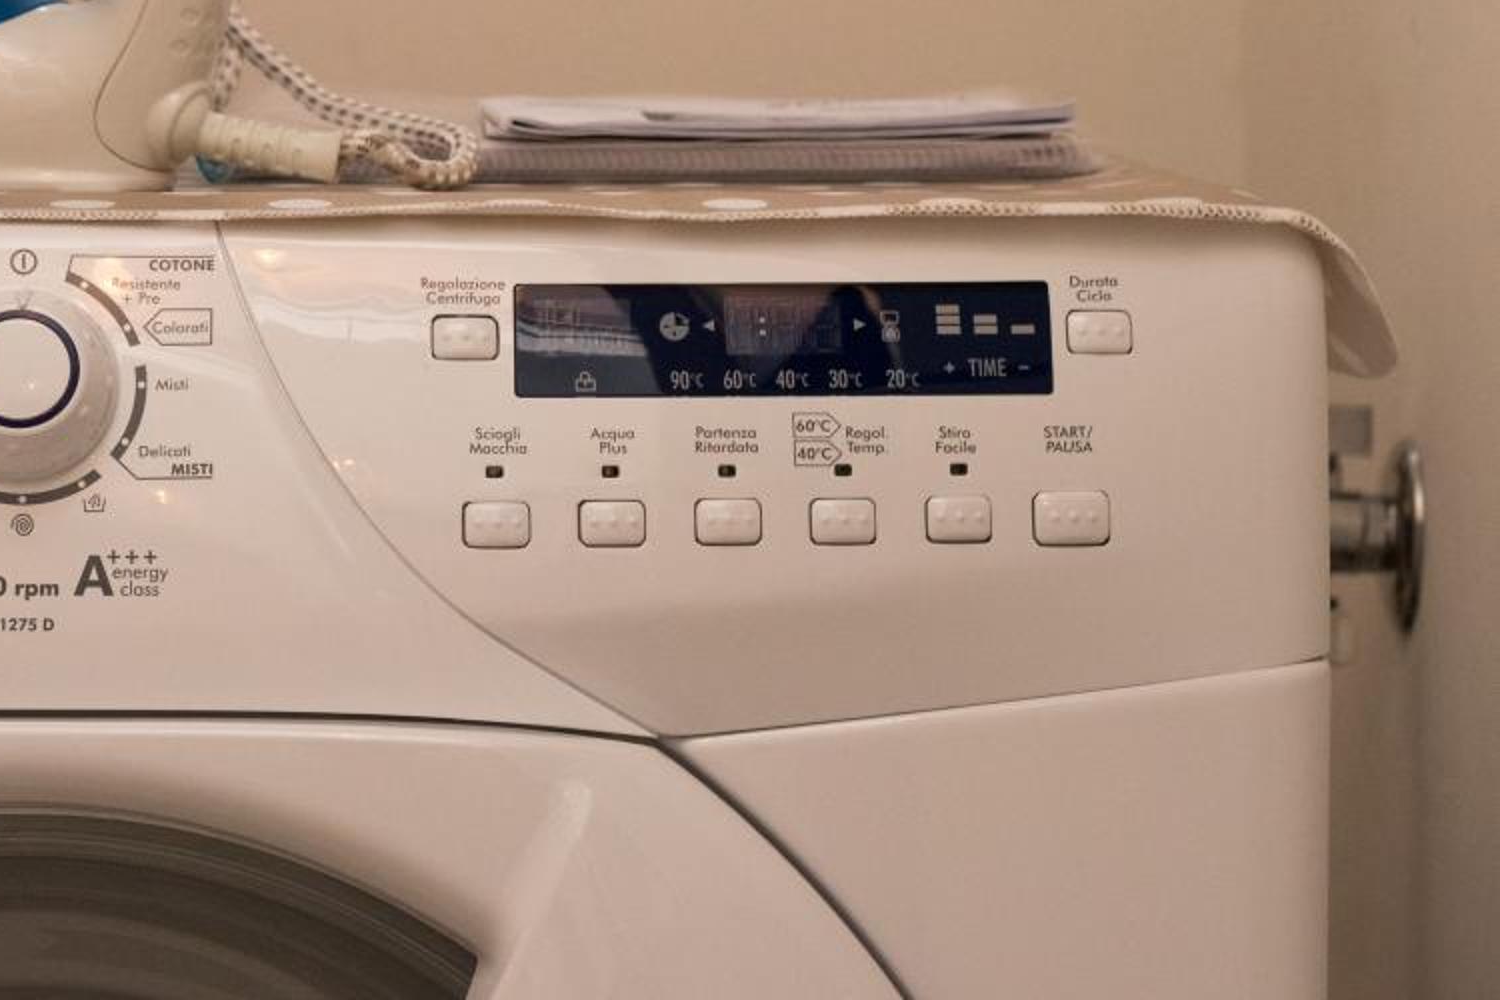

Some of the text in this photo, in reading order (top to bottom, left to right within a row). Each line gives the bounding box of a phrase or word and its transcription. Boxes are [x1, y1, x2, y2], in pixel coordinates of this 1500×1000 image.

[148, 258, 216, 272] COTONE
[111, 277, 181, 291] Resistente
[420, 278, 505, 294] Regolazione
[1069, 275, 1118, 290] Durata
[426, 292, 501, 308] Centrifuga
[1077, 290, 1112, 303] Ciclo
[152, 321, 209, 334] Colorati
[968, 357, 1008, 378] TIME
[155, 378, 189, 391] Misti
[474, 426, 521, 443] Sciogli
[591, 427, 635, 443] Acqua
[695, 426, 757, 439] Partenza
[939, 425, 971, 439] Stiro
[1044, 425, 1093, 440] START/
[139, 444, 191, 457] Delicati
[469, 440, 527, 455] Macchia
[599, 441, 627, 455] Plus
[695, 440, 758, 453] Ritardata
[935, 440, 977, 454] Facile
[1046, 440, 1093, 453] PAUSA
[171, 463, 213, 476] MISTI
[112, 567, 169, 588] energy
[14, 580, 60, 602] rpm
[120, 584, 160, 597] class
[0, 617, 37, 632] 1275
[43, 617, 55, 632] D
